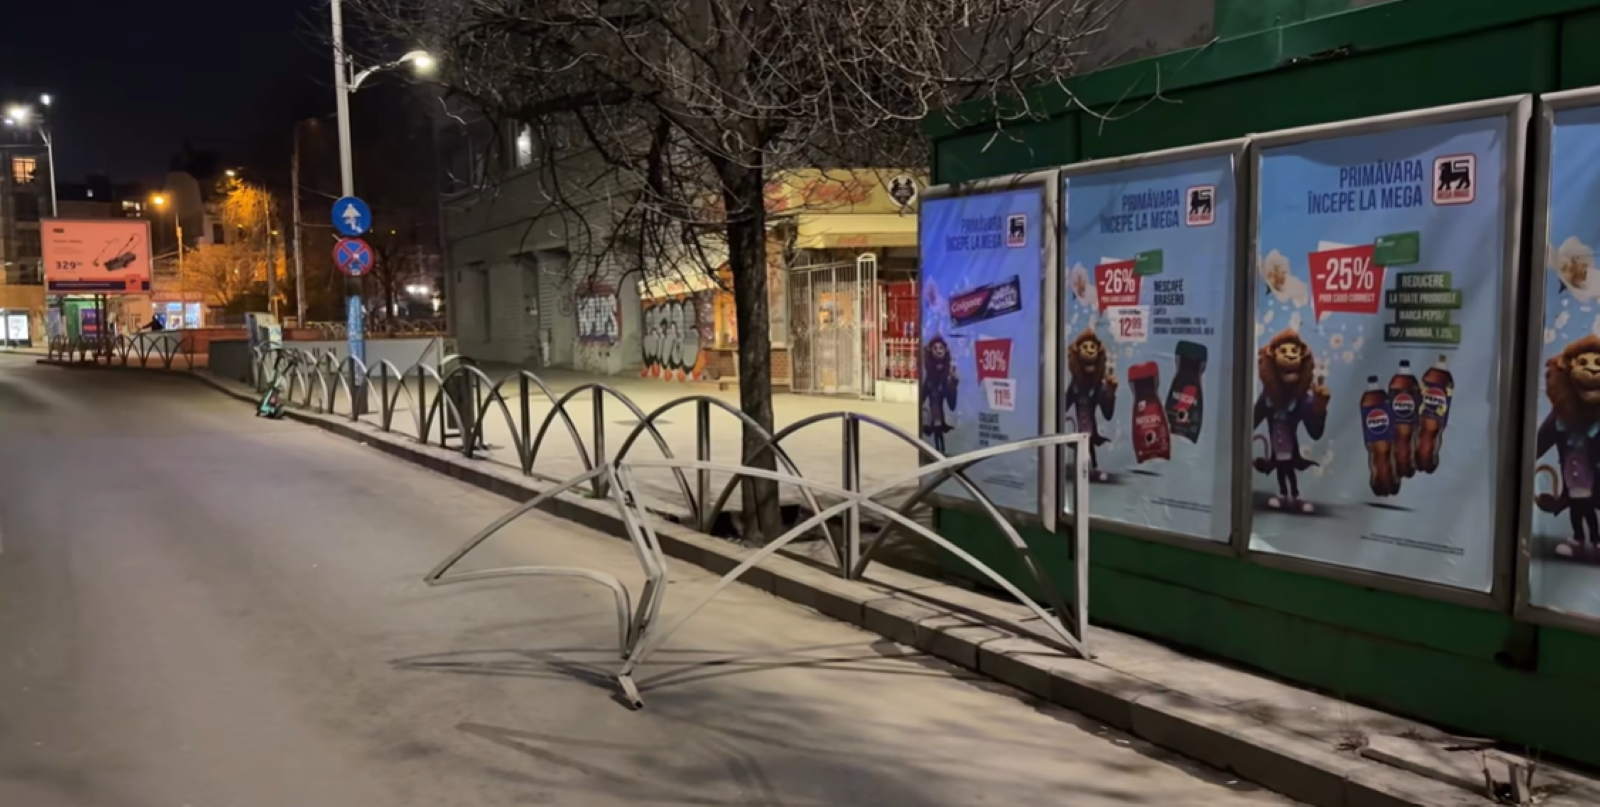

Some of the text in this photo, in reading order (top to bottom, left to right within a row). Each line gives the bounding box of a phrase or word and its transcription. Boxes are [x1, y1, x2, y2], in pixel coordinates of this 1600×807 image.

[1339, 159, 1423, 188] PRIMĂVARA
[1122, 188, 1180, 212] PRIMĂVARA
[1307, 185, 1423, 214] ÎNCEPE LA MEGA
[1099, 209, 1180, 234] ÎNCEPE LA MEGA
[55, 260, 77, 270] 329
[1316, 256, 1375, 291] -25%
[1099, 267, 1136, 294] -26%
[1401, 274, 1444, 288] REDUCERE
[978, 349, 1007, 372] -30%
